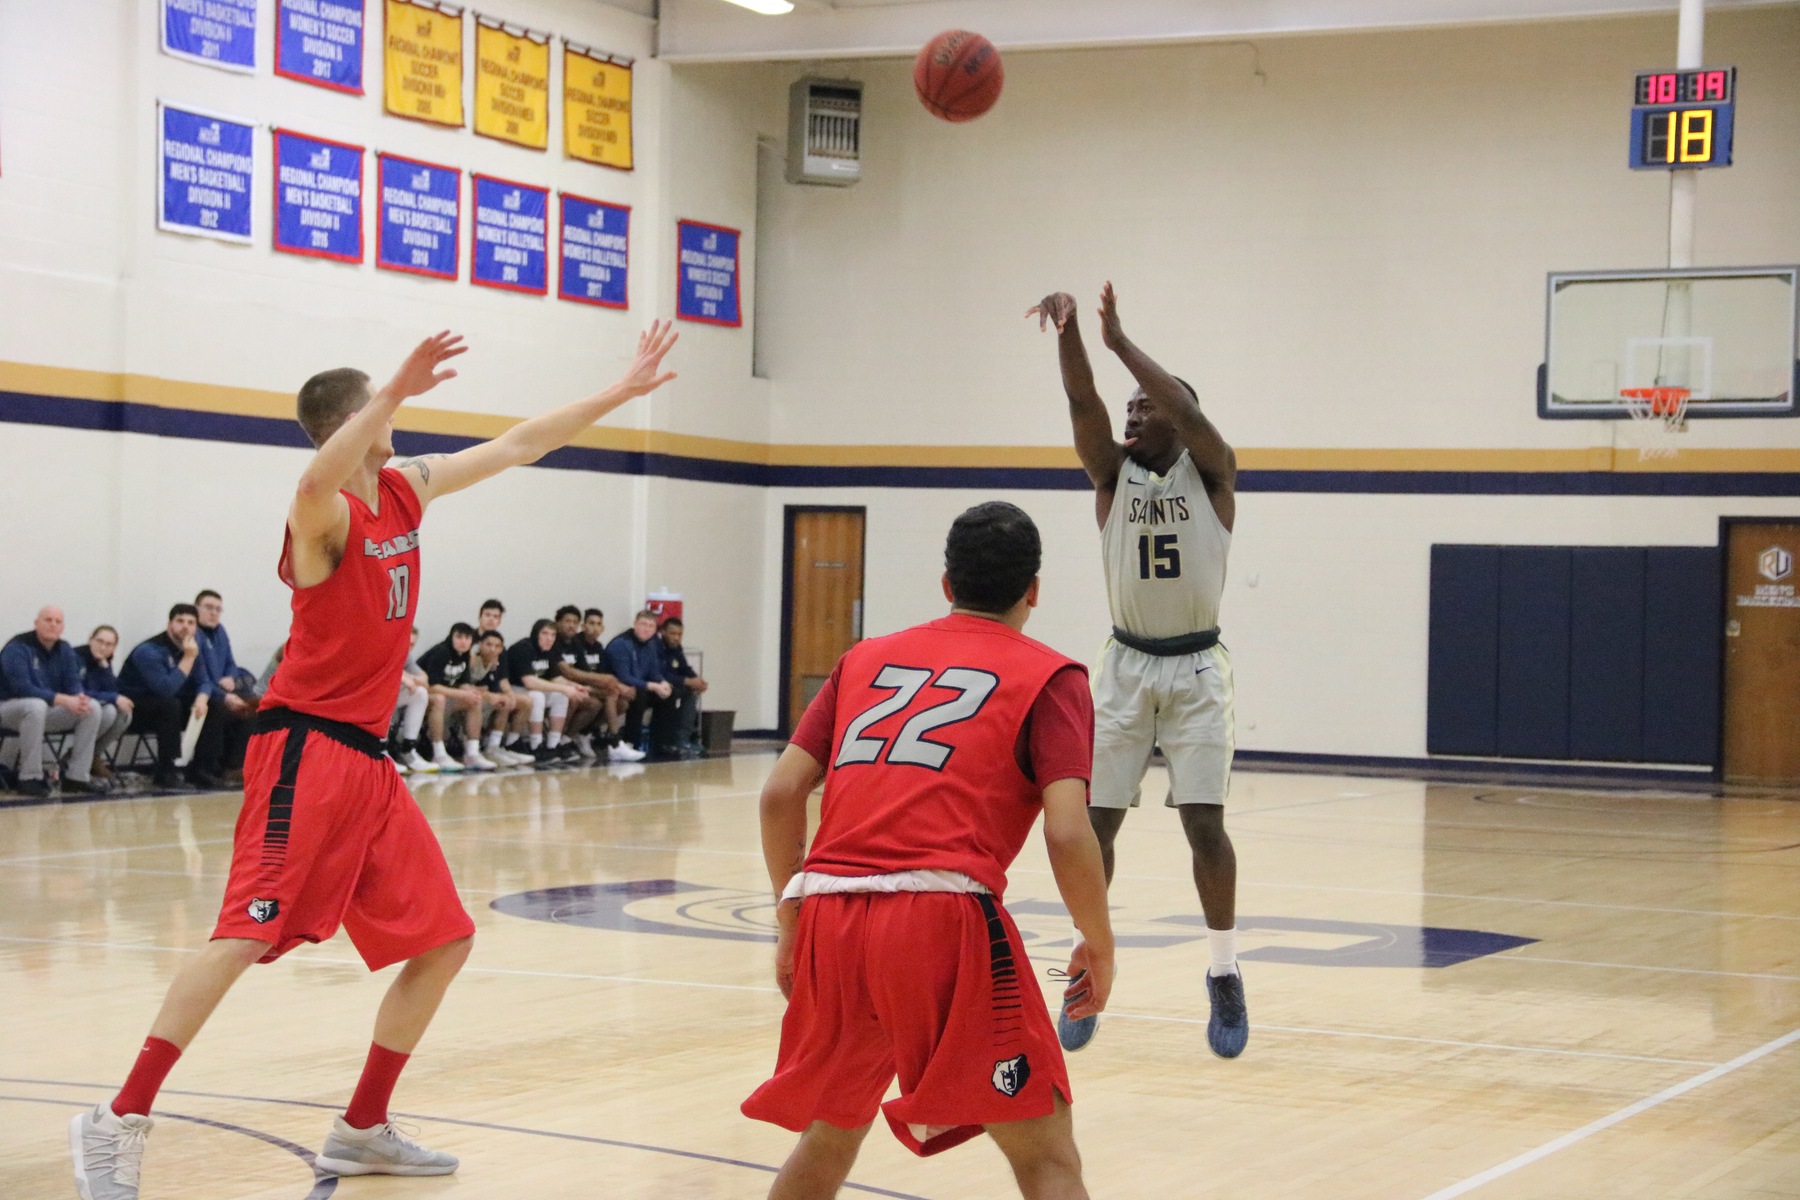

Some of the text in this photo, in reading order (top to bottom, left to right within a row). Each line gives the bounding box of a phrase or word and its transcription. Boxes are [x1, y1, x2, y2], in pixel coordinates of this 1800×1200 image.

[190, 16, 226, 40] DIVISION
[289, 12, 355, 46] WOMEN'S SOCCER
[320, 1, 362, 28] CHAMPIONS
[303, 35, 336, 60] DIVISION
[1666, 109, 1713, 164] 18
[165, 138, 252, 176] REGIONAL CHAMPIONS
[170, 160, 246, 193] MEN'S BASKETBALL
[280, 165, 359, 198] REGIONAL CHAMPIONS
[187, 185, 223, 209] DIVISION
[285, 185, 353, 216] MEN'S BASKETBALL
[383, 186, 457, 218] REGIONAL CHAMPIONS
[301, 207, 333, 231] DIVISION
[388, 205, 452, 236] MEN'S BASKETBALL
[478, 205, 545, 235] REGIONAL CHAMPIONS
[403, 227, 433, 249] DIVISION
[477, 224, 545, 252] WOMEN'S VOLLEYBALL
[563, 224, 627, 252] REGIONAL CHAMPIONS
[493, 245, 522, 265] DIVISION
[563, 241, 627, 269] WOMEN'S VOLLEYBALL
[579, 261, 606, 281] DIVISION
[1129, 496, 1190, 525] SAINTS
[1138, 533, 1181, 580] 15
[833, 663, 1001, 773] 22
